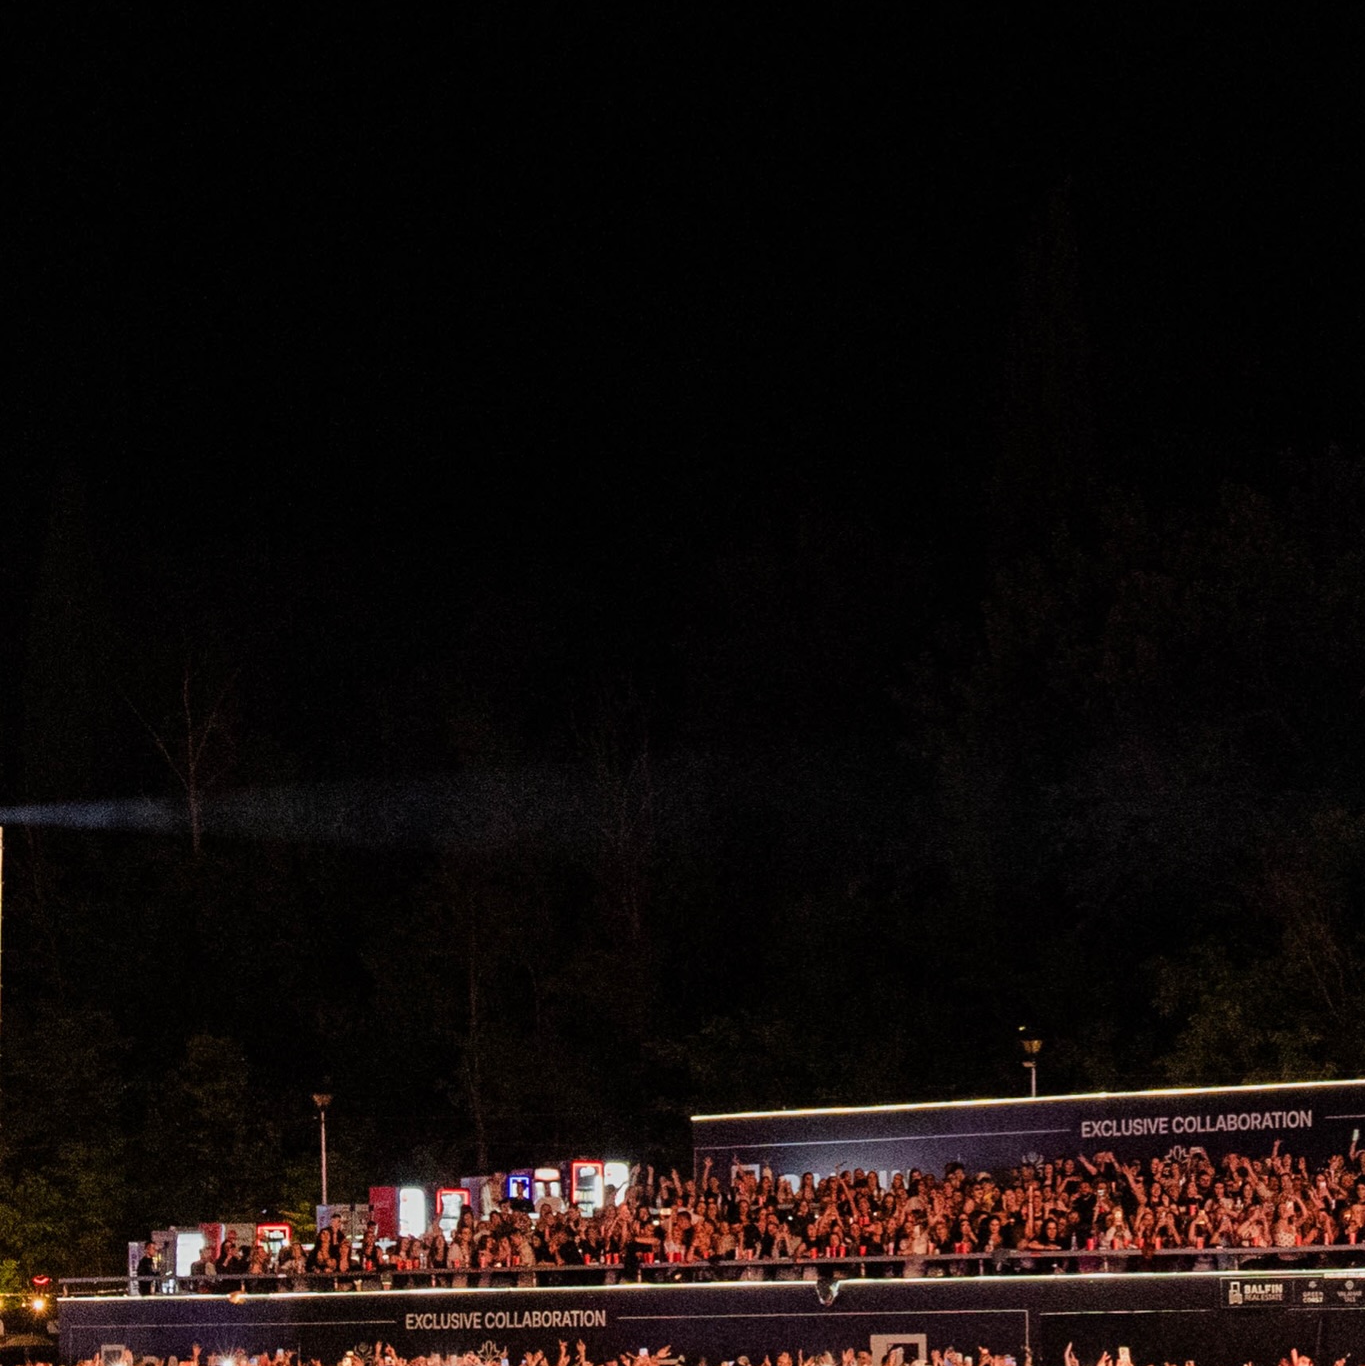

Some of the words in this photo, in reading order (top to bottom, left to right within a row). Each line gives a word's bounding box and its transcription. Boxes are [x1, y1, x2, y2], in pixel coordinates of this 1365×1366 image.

[1081, 1117, 1169, 1137] EXCLUSIVE
[1172, 1110, 1313, 1133] COLLABORATION
[1244, 1284, 1283, 1294] BALFIN
[405, 1313, 482, 1330] EXCLUSIVE
[485, 1310, 606, 1329] COLLABORATION
